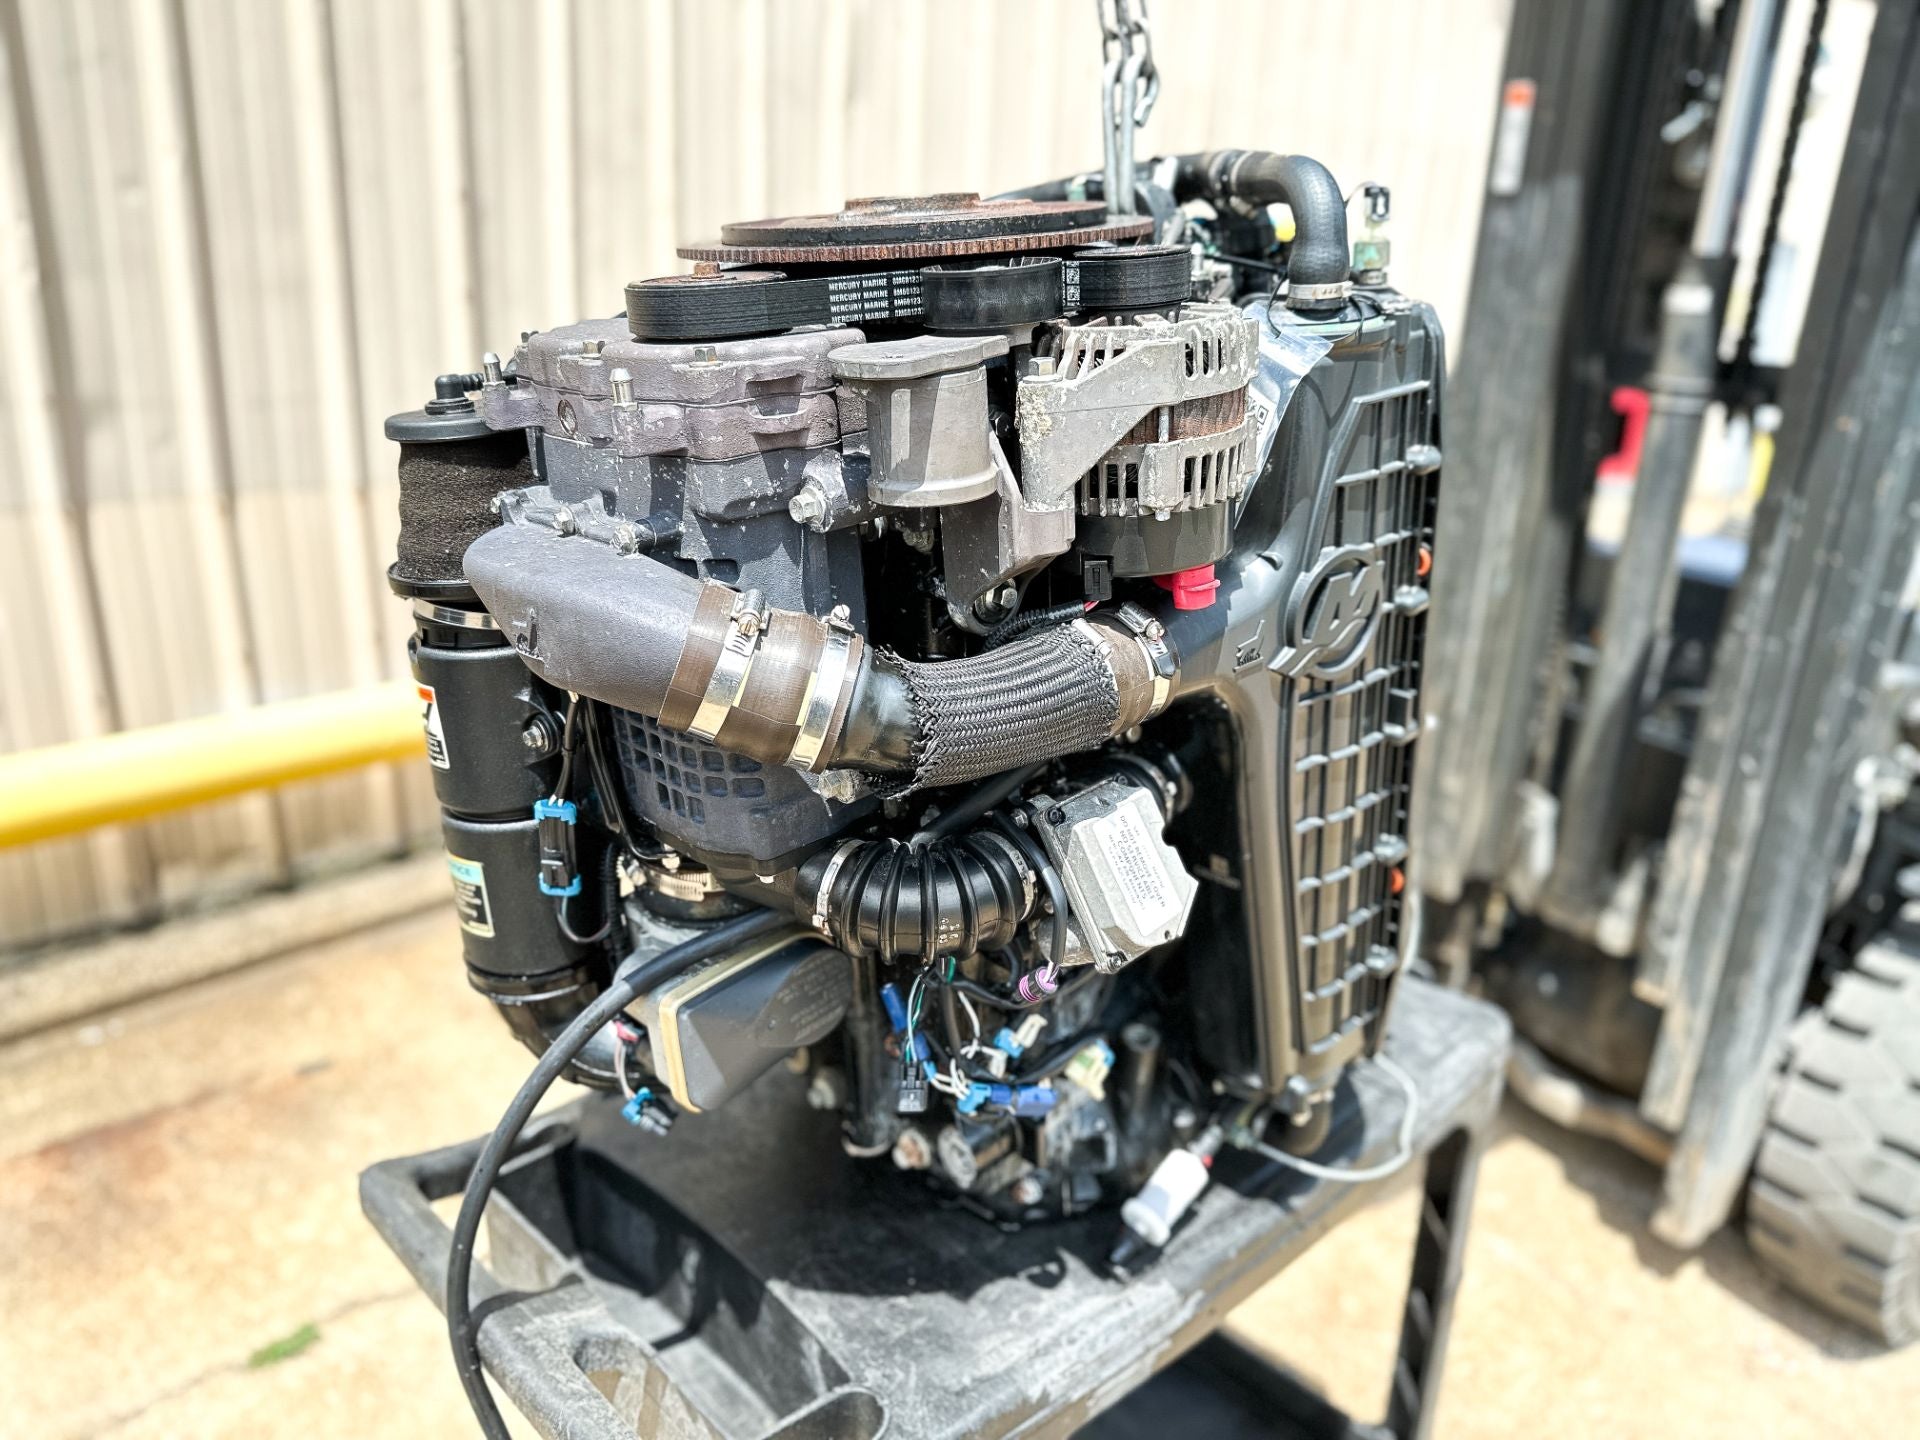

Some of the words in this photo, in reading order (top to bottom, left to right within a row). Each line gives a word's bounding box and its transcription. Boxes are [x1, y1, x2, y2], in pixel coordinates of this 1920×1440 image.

[829, 281, 860, 291] MERCURY
[863, 278, 887, 287] MARINE
[830, 292, 861, 302] MERCURY
[863, 289, 888, 299] MARINE
[831, 302, 862, 312] MERCURY
[864, 300, 889, 309] MARINE
[832, 313, 863, 323] MERCURY
[865, 310, 890, 320] MARINE
[1133, 846, 1153, 878] REMOVE
